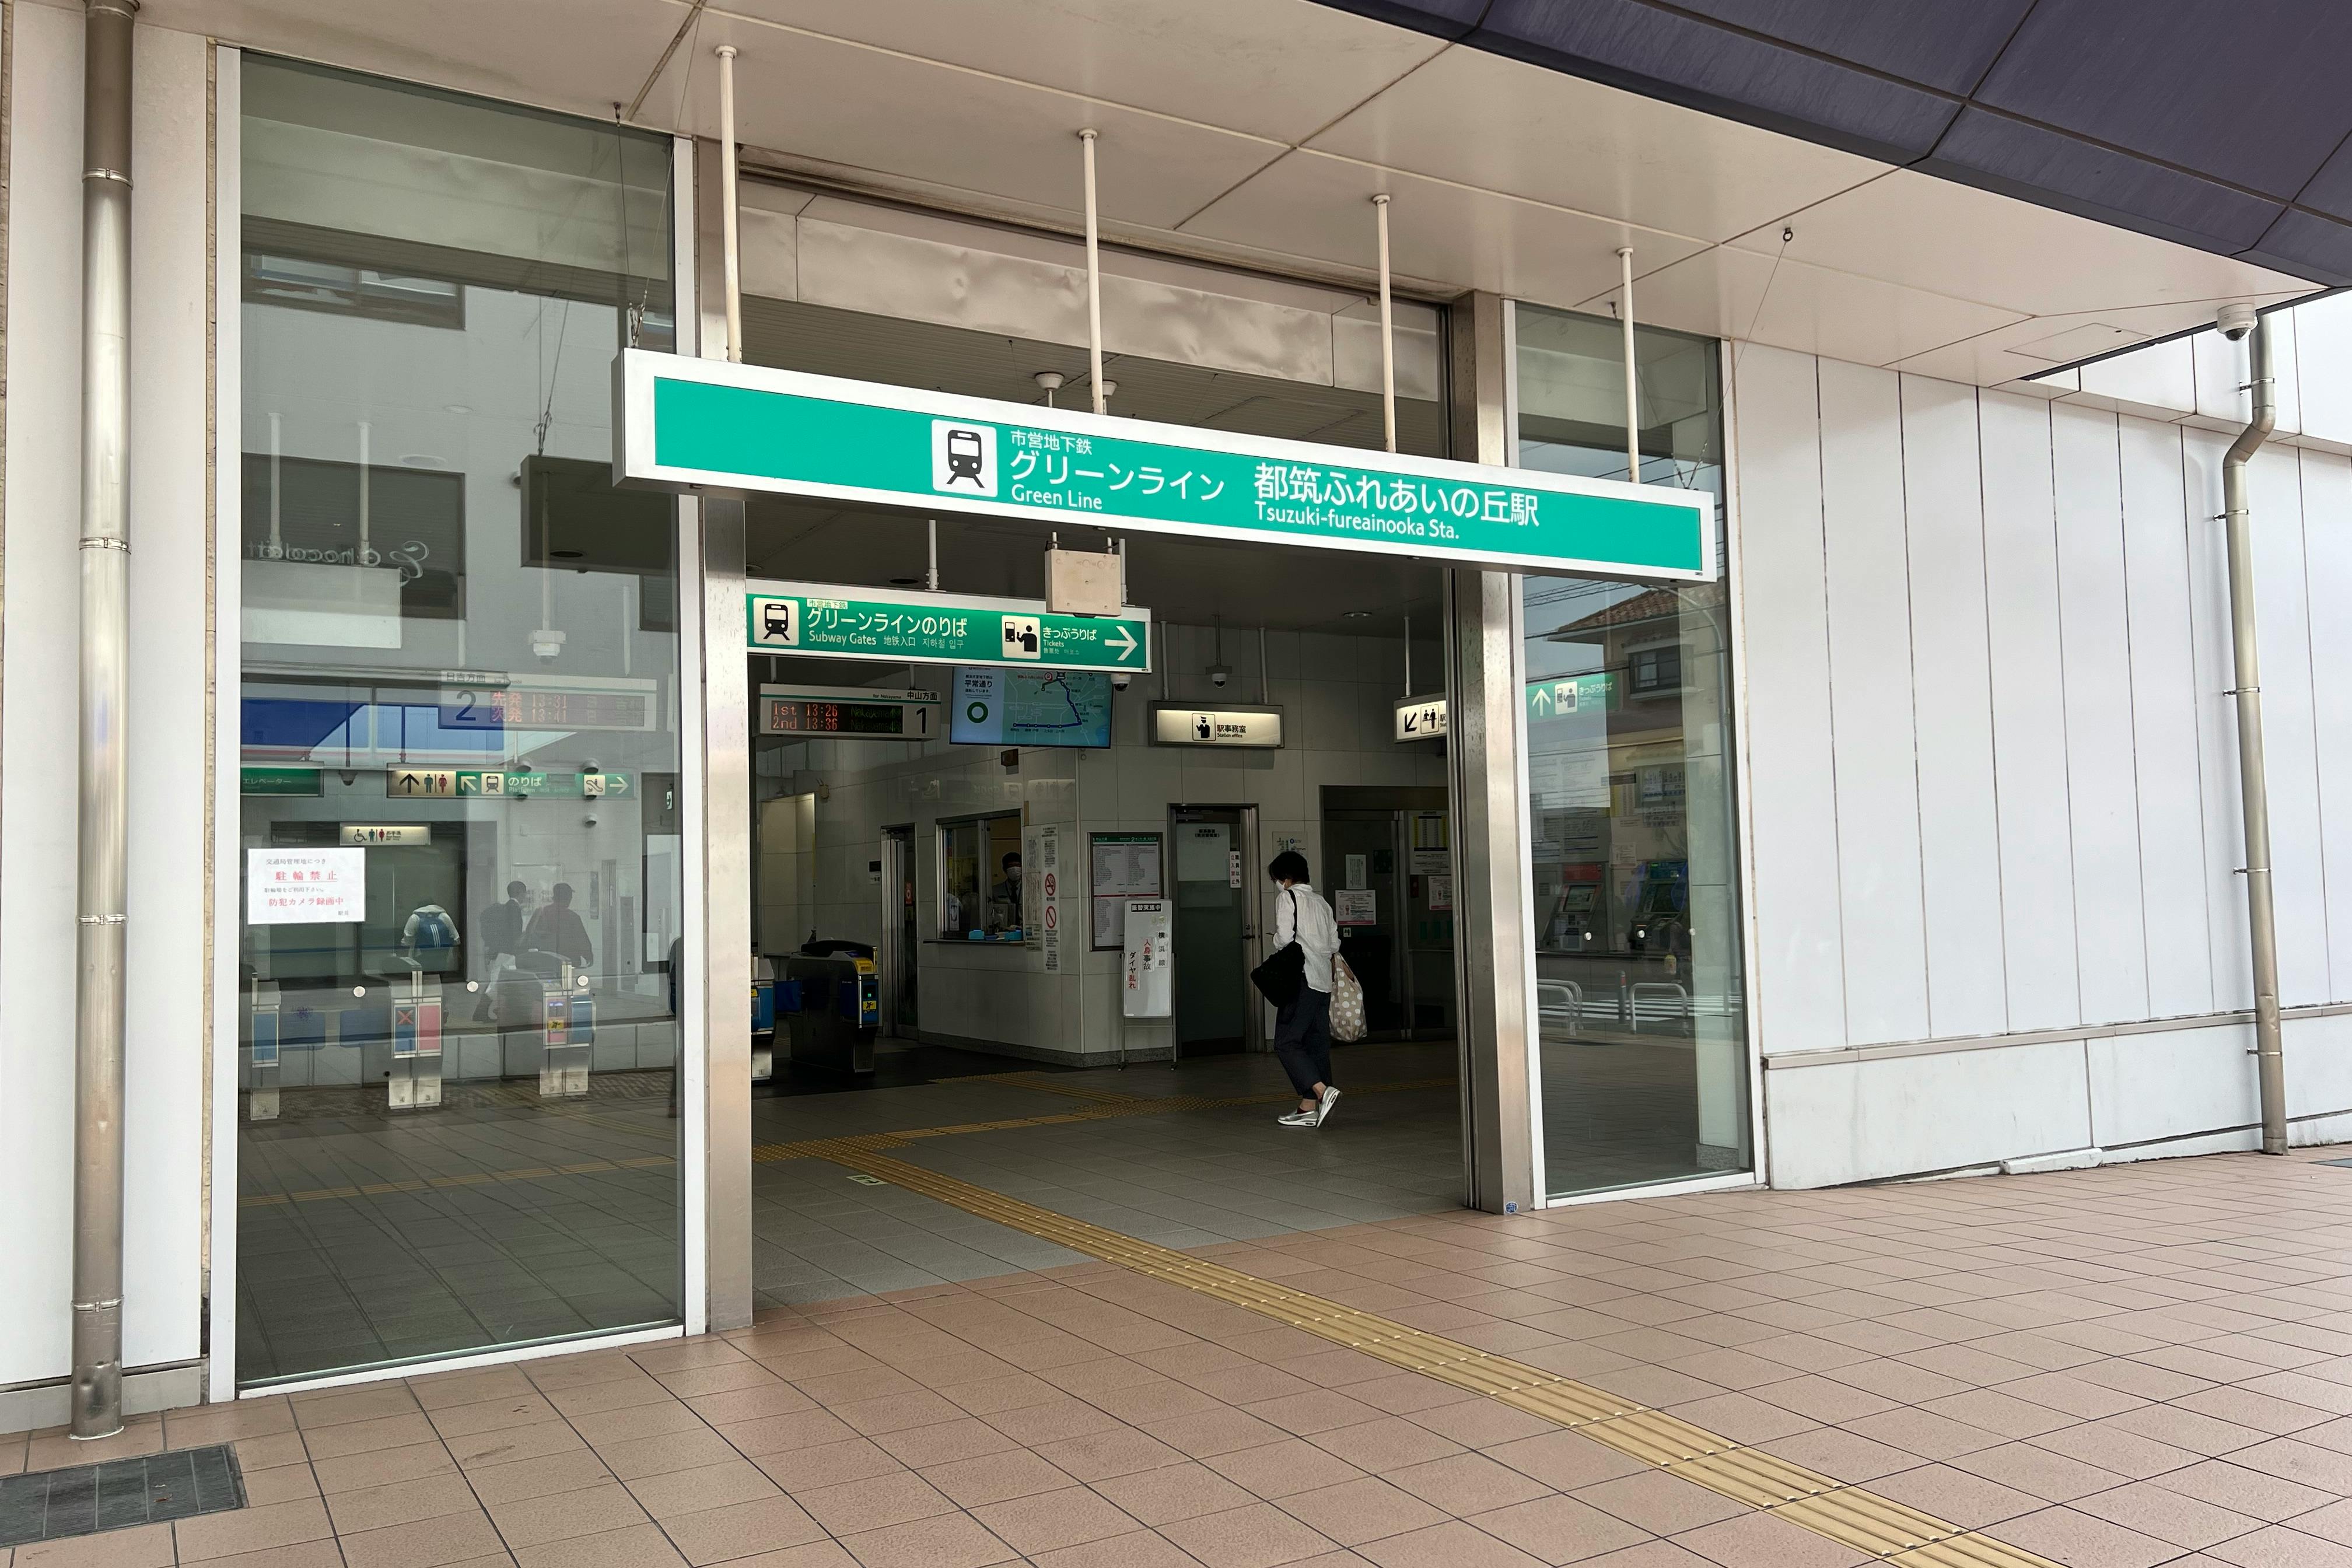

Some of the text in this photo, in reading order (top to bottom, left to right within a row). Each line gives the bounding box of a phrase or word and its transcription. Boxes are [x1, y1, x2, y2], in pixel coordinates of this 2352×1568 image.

[1010, 429, 1092, 456] 市営地下鉄
[1010, 450, 1224, 502] グリーンライン
[1012, 484, 1102, 510] Green Line
[1254, 462, 1540, 527] 都筑ふれあいの丘駅
[1255, 501, 1460, 540] Tsuzuki-fureainooka Sta.
[808, 599, 847, 610] 市営地下鉄
[807, 608, 968, 637] グリーンラインのりば
[809, 630, 876, 646] Subway Gates
[1042, 626, 1097, 640] きっぷうりば
[883, 635, 916, 647] 地铁入口
[922, 638, 964, 649] 지하철 입구
[1043, 639, 1065, 648] Tickets
[446, 672, 486, 682] 日吉方面
[964, 680, 993, 688] 平常通り
[907, 691, 937, 701] 中山方面
[1578, 682, 1612, 696] きっぷうりば
[456, 690, 476, 721] 2
[492, 691, 523, 708] 先発
[531, 694, 567, 709] 13:31
[492, 707, 523, 723] 次発
[531, 708, 567, 723] 13:41
[774, 702, 797, 716] 1st
[806, 704, 838, 717] 13:26
[773, 716, 797, 729] 2nd
[806, 718, 838, 730] 13:36
[916, 707, 926, 734] 1
[1217, 724, 1246, 733] 駅事務室
[508, 777, 542, 786] のりば
[275, 870, 338, 881] 駐輪禁止
[269, 897, 344, 907] 防犯カメラ録画中
[1143, 939, 1152, 970] 人身事故
